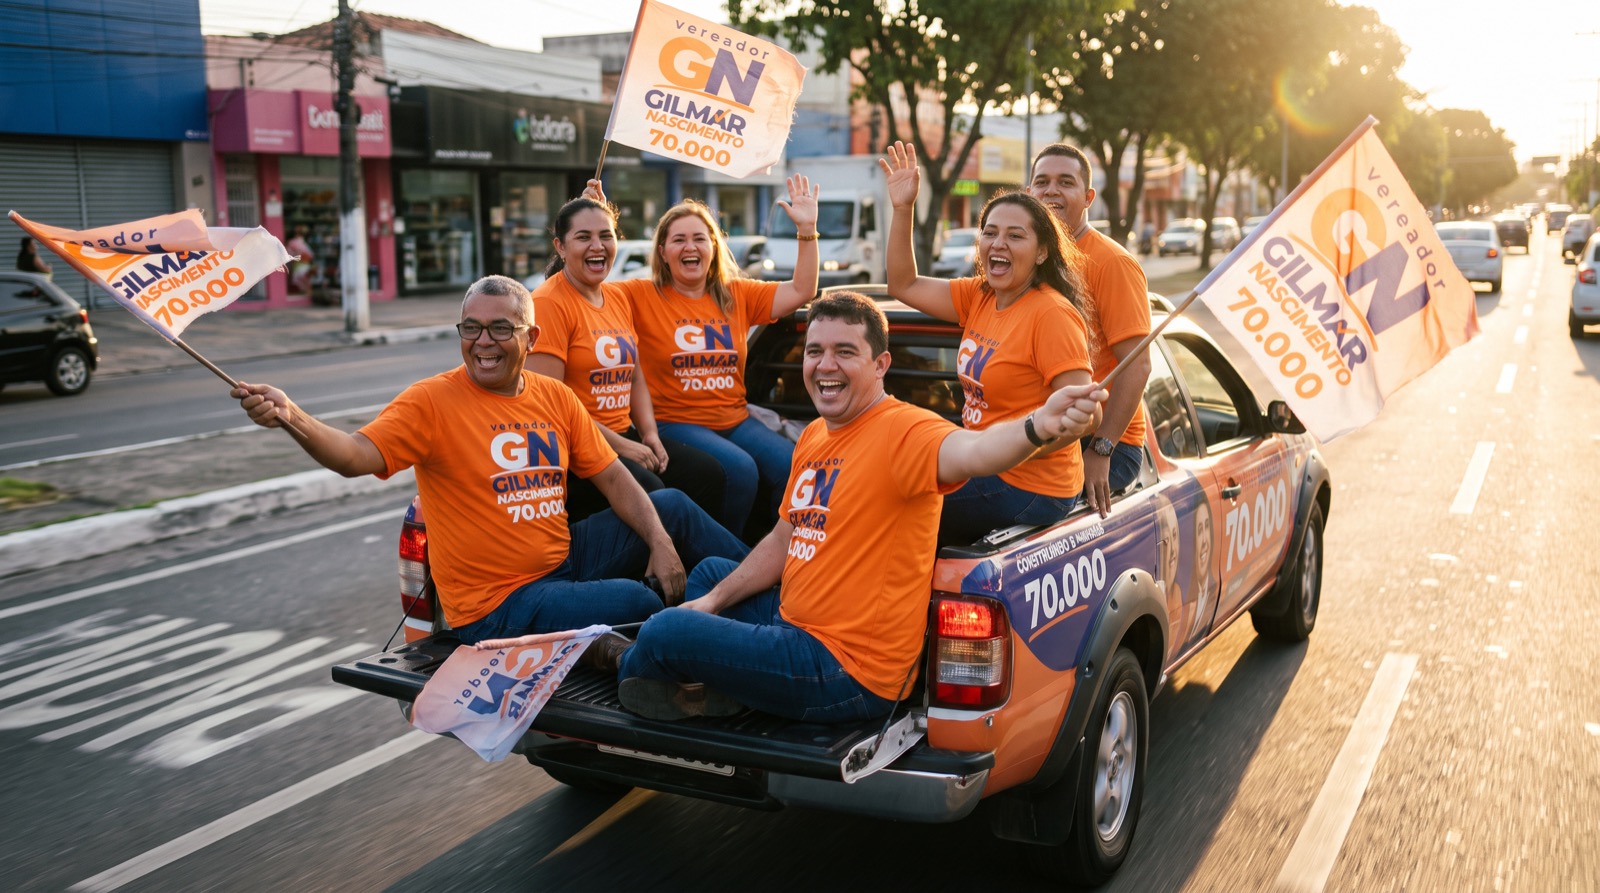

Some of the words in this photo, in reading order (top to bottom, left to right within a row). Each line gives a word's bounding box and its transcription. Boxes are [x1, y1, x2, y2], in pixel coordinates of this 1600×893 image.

[675, 19, 770, 60] vereador
[658, 36, 766, 107] GN
[644, 89, 747, 136] GILMAR
[645, 109, 745, 149] NASCIMENTO
[649, 128, 731, 167] 70.000
[1367, 166, 1446, 290] vereador
[1310, 187, 1431, 336] GN
[153, 267, 245, 328] 70.000
[1262, 236, 1368, 372] GILMAR
[674, 324, 734, 352] GN
[1227, 286, 1324, 399] 70.000
[1247, 261, 1352, 386] NASCIMENTO
[594, 334, 637, 368] GN
[671, 353, 739, 369] GILMAR
[674, 366, 738, 377] NASCIMENTO
[956, 338, 996, 382] GN
[680, 375, 735, 392] 70.000
[490, 420, 552, 431] vereador
[490, 431, 560, 471] GN
[492, 471, 563, 494] GILMAR
[497, 485, 564, 505] NASCIMENTO
[790, 468, 841, 509] GN
[507, 498, 565, 524] 70.000
[1225, 478, 1287, 572] 70.000
[1024, 547, 1107, 630] 70.000
